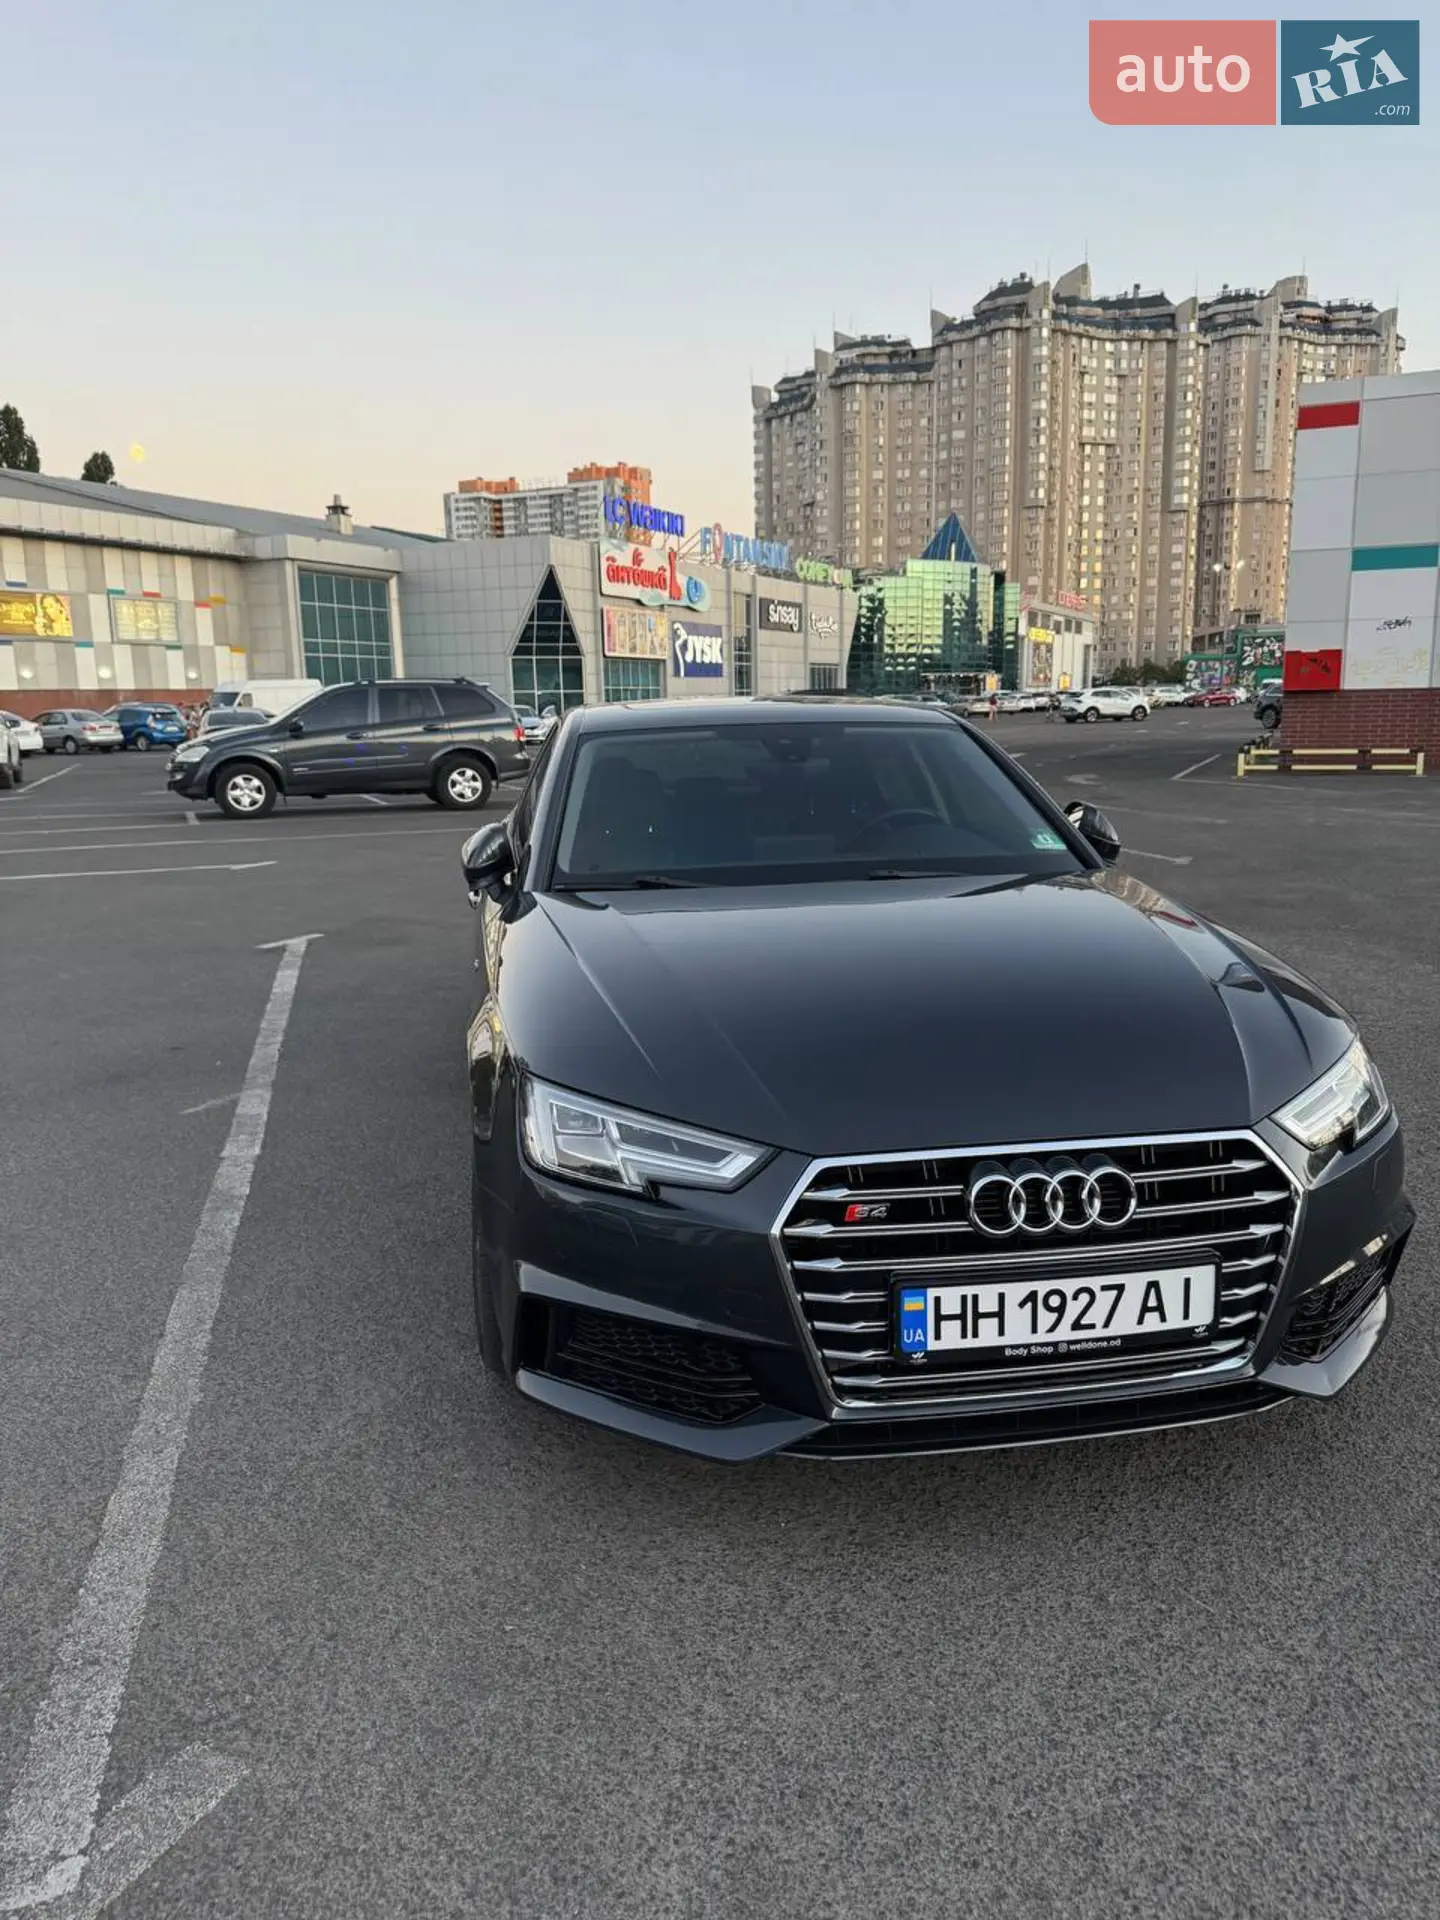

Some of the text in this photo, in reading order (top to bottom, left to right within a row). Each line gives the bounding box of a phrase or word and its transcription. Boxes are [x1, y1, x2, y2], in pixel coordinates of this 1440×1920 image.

[685, 635, 722, 664] JYSK
[933, 1292, 1006, 1341] HH
[1017, 1284, 1126, 1334] 1927
[904, 1328, 925, 1343] UA
[1004, 1346, 1028, 1357] Body
[1030, 1344, 1054, 1355] Shop
